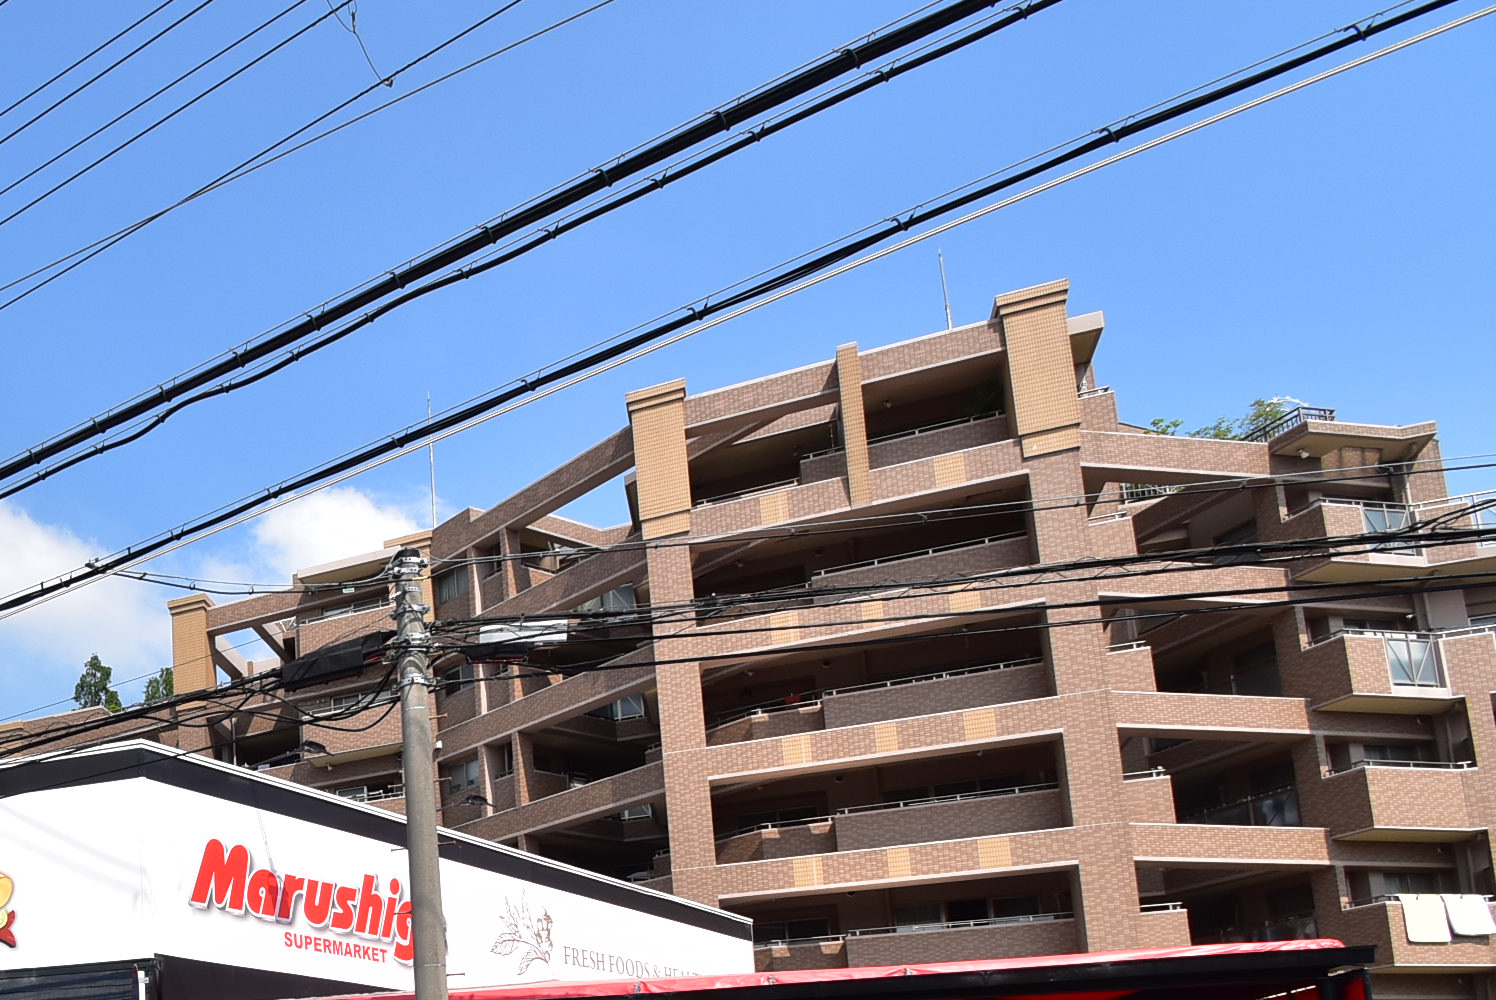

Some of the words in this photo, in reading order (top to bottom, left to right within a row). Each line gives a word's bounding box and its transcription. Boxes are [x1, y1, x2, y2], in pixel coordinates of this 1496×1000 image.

[190, 837, 415, 963] Marushig
[284, 931, 388, 963] SUPERMARKET
[563, 945, 606, 972] FRESH
[609, 954, 650, 979] FOODS
